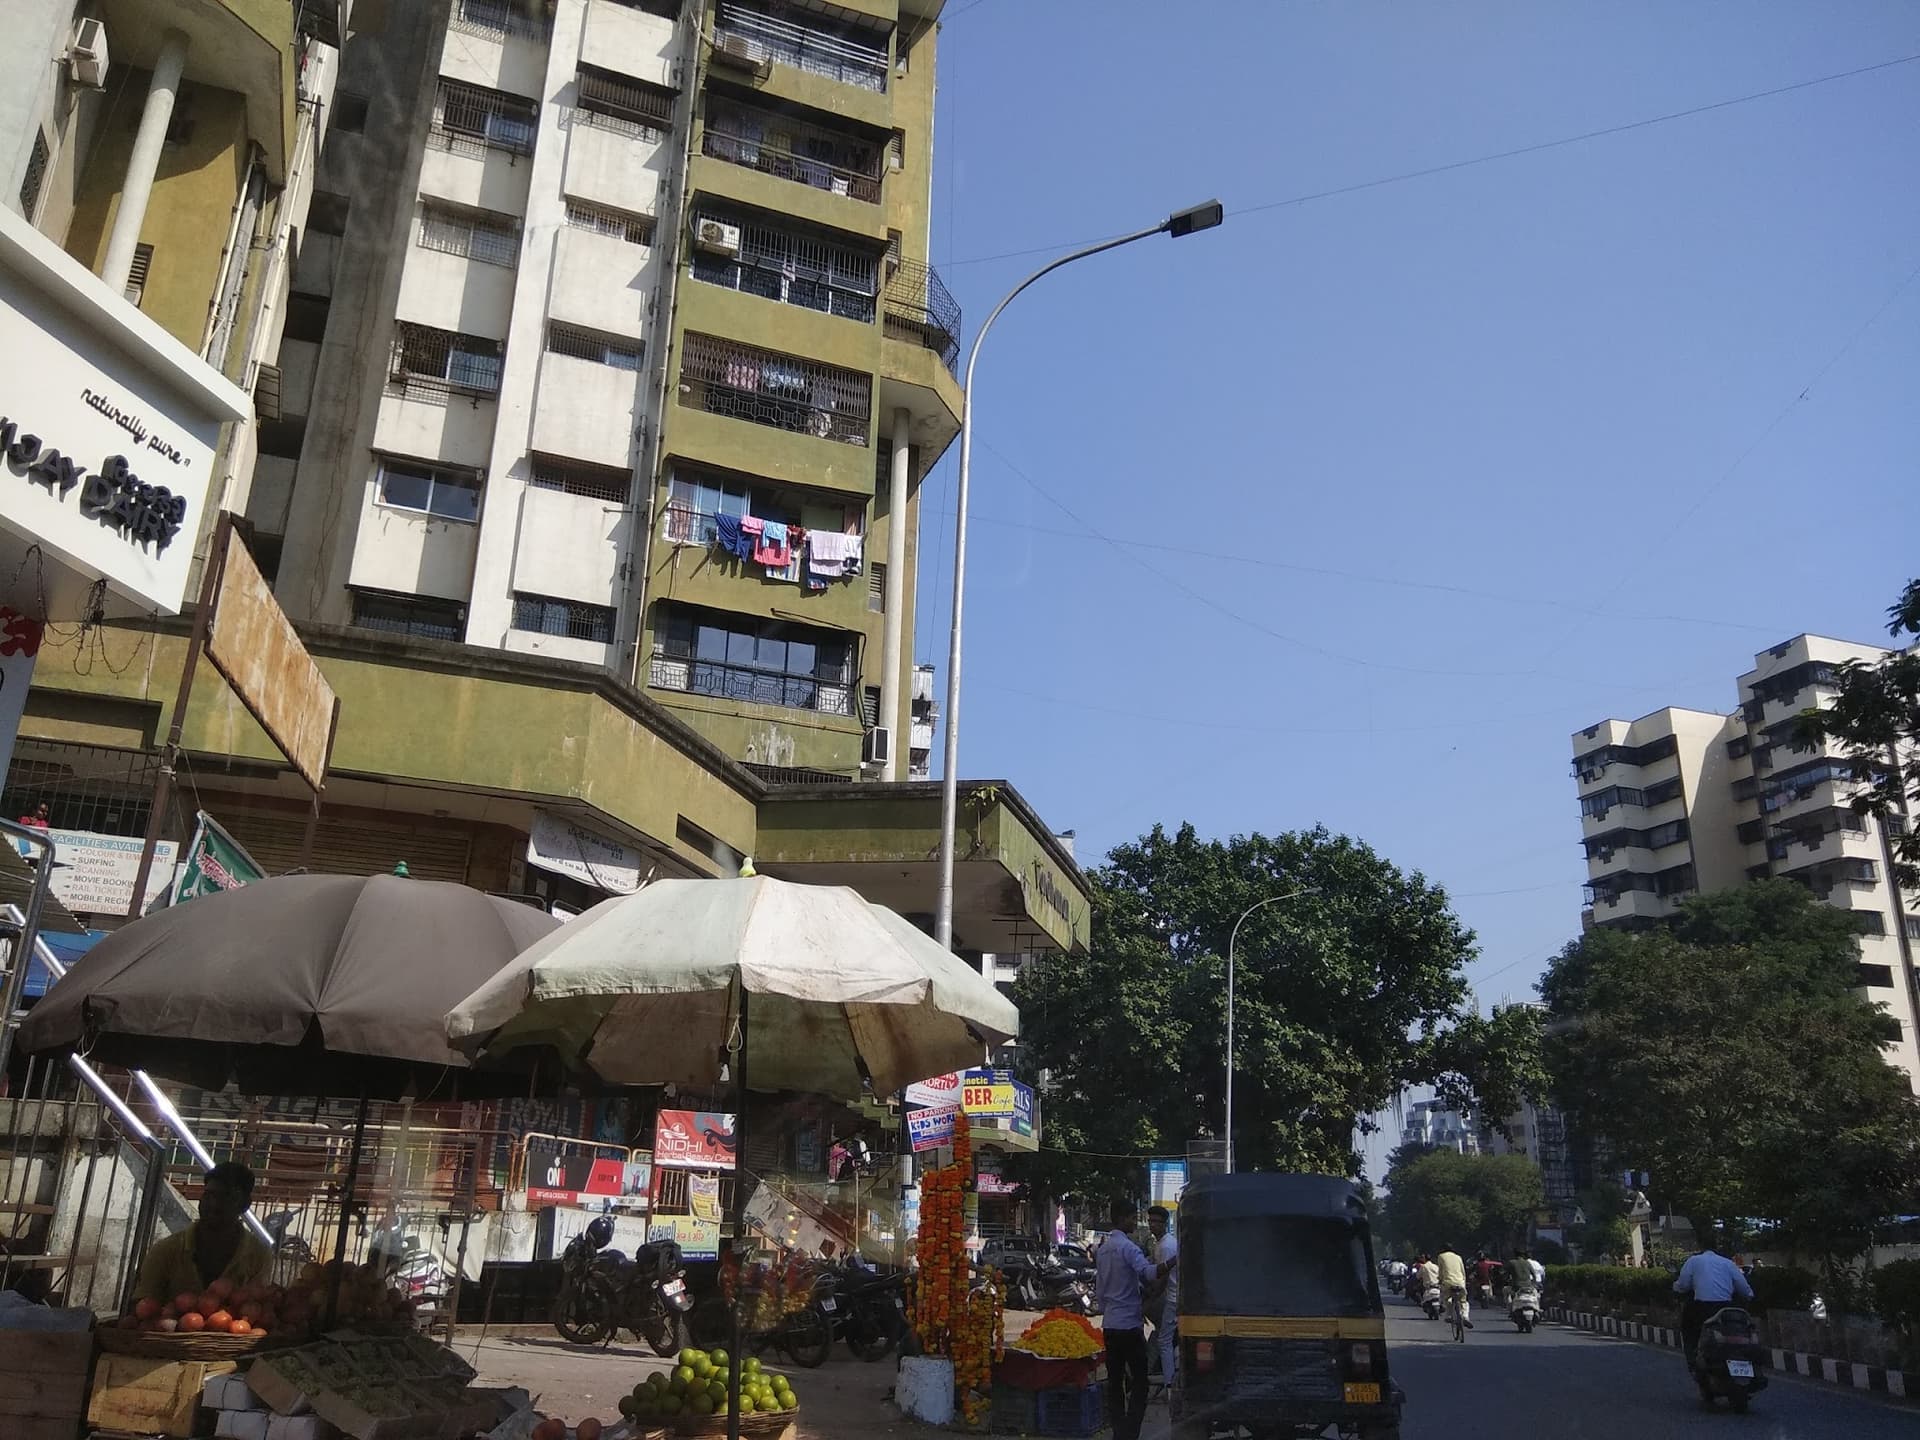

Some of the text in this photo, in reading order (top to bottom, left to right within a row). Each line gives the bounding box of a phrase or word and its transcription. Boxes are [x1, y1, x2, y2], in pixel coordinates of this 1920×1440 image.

[81, 388, 182, 465] naturally pure
[50, 833, 170, 855] FACILITIES AVAILLE
[79, 847, 116, 859] COLOUR
[78, 857, 115, 867] SURFING
[75, 866, 121, 877] SCANNING
[73, 875, 101, 885] MOVIE
[71, 884, 91, 893] RAIL
[94, 886, 123, 896] TICKET
[69, 893, 104, 903] MOBILE
[965, 1088, 992, 1106] BER
[911, 1112, 923, 1121] NO
[924, 1104, 959, 1117] PARKING
[658, 1138, 703, 1153] NIDHI
[657, 1150, 687, 1159] Herbal
